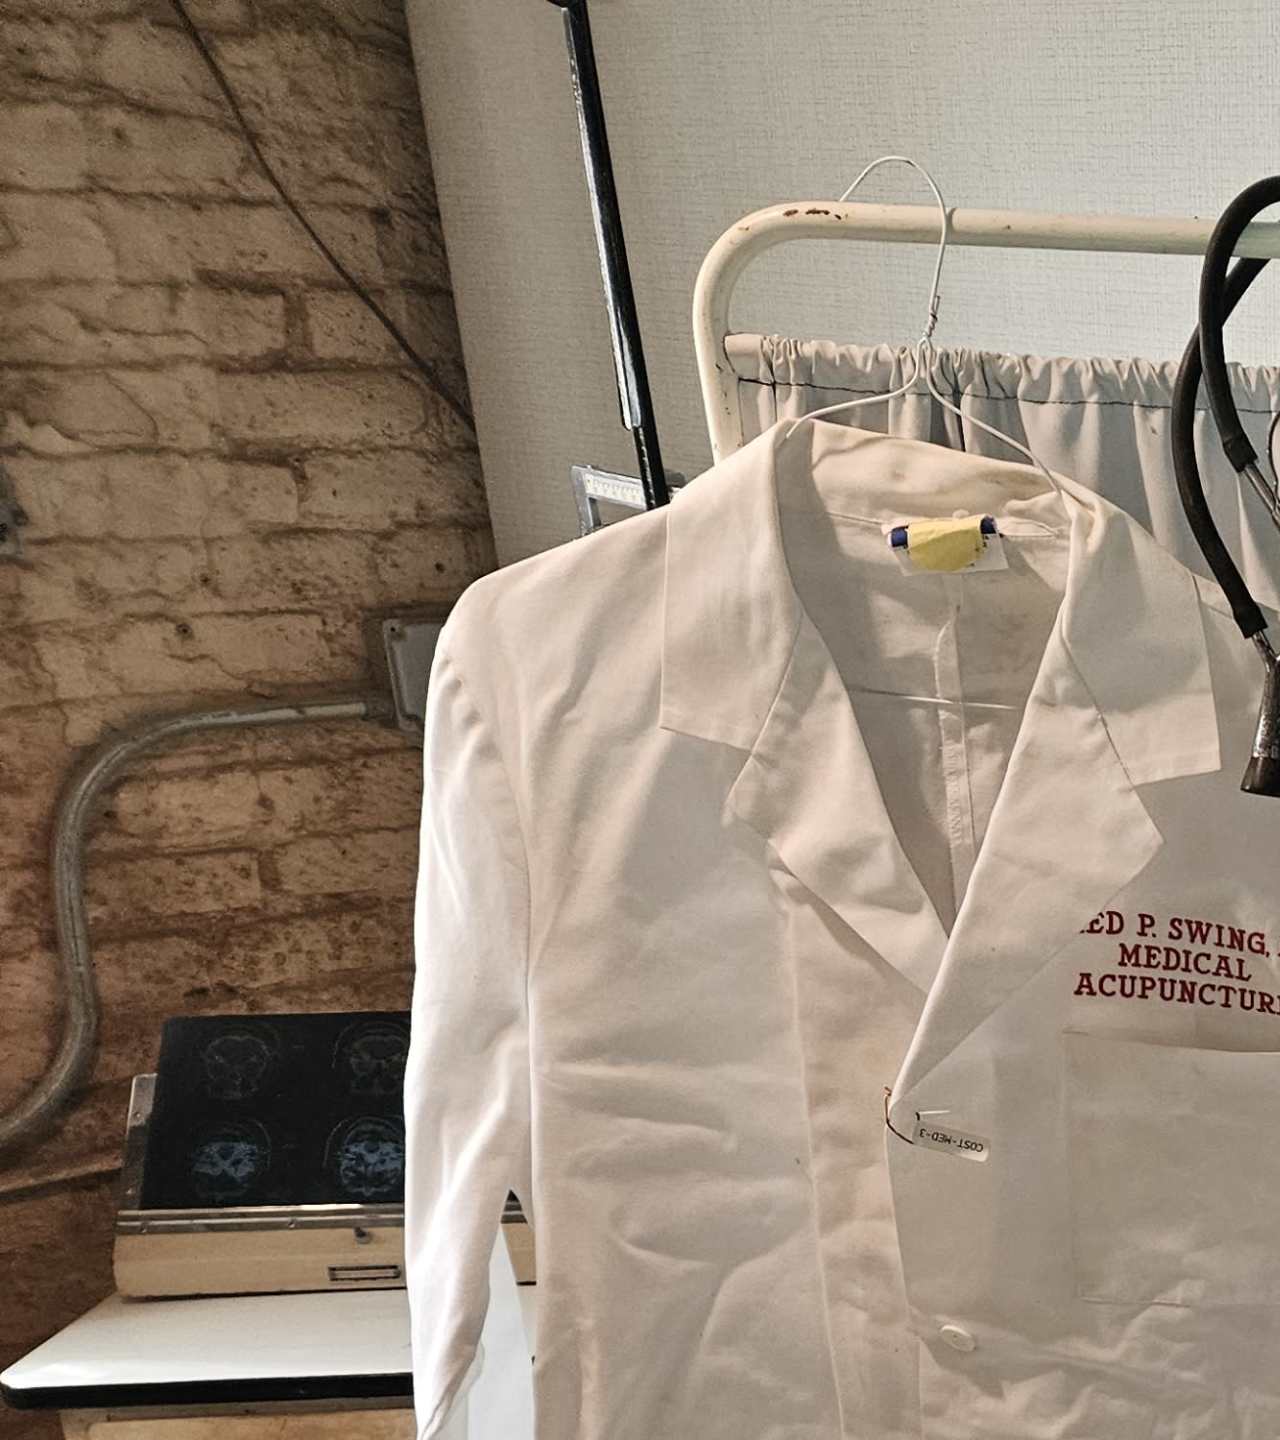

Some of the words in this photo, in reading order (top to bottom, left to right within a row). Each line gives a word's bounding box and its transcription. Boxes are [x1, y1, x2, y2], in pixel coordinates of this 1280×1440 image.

[1080, 911, 1125, 935] ED
[1136, 913, 1157, 938] P.
[1168, 917, 1271, 958] SWING,
[1117, 942, 1253, 982] MEDICAL
[919, 1128, 984, 1152] COST-MED-3
